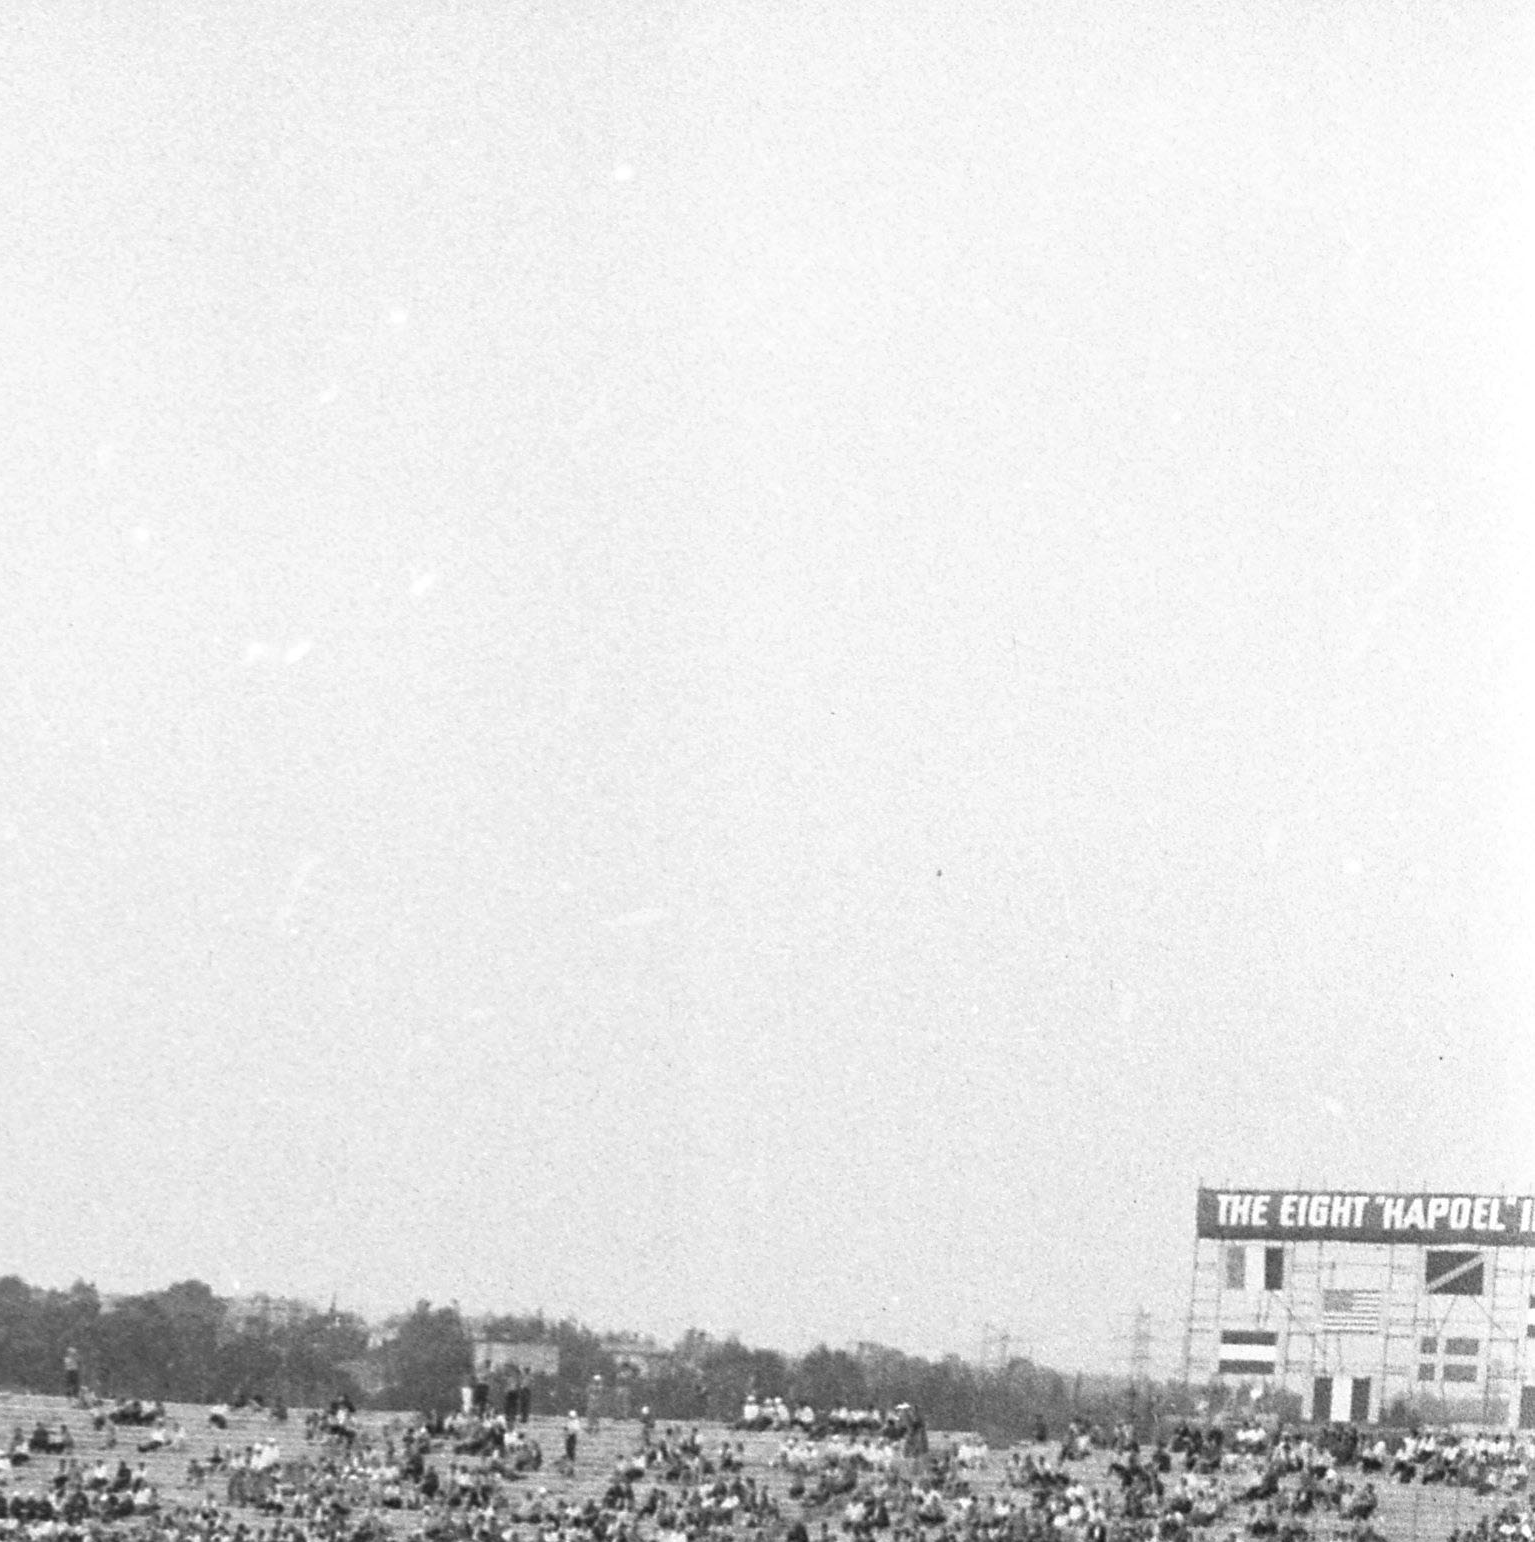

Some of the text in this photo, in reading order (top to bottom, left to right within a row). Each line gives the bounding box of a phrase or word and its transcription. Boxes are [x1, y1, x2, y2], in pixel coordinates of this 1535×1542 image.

[1218, 1195, 1270, 1227] THE
[1280, 1195, 1370, 1228] EIGHT
[1519, 1198, 1535, 1232] I
